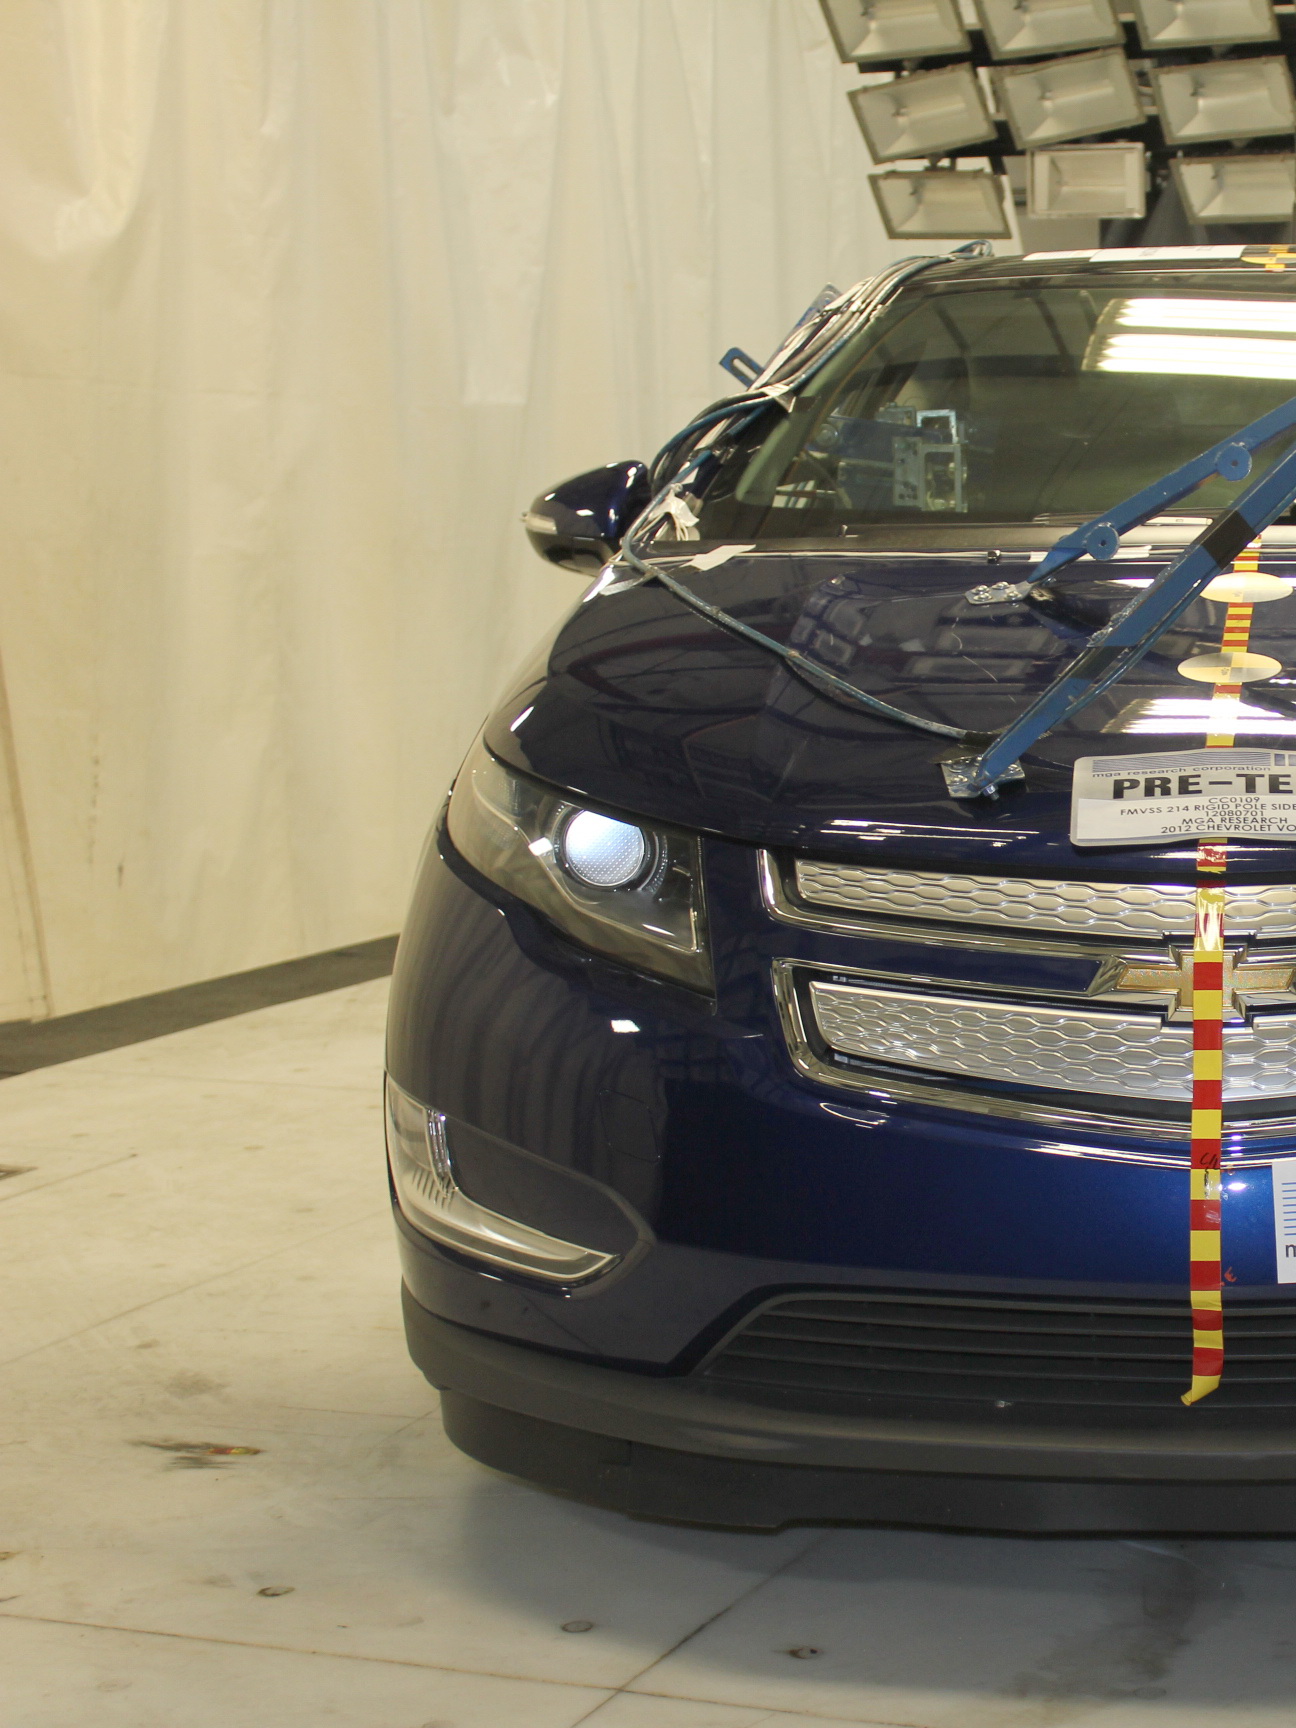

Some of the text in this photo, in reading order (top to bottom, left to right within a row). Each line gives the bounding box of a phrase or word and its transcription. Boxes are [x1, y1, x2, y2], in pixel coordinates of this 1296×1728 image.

[1128, 768, 1187, 776] research
[1120, 807, 1163, 816] FMVSS
[1167, 805, 1190, 813] 214
[1235, 803, 1267, 811] POLE
[1205, 809, 1264, 817] 12080701
[1182, 817, 1288, 825] MGA RESEARCH
[1161, 825, 1192, 834] 2012
[1196, 824, 1272, 832] CHEVROLET
